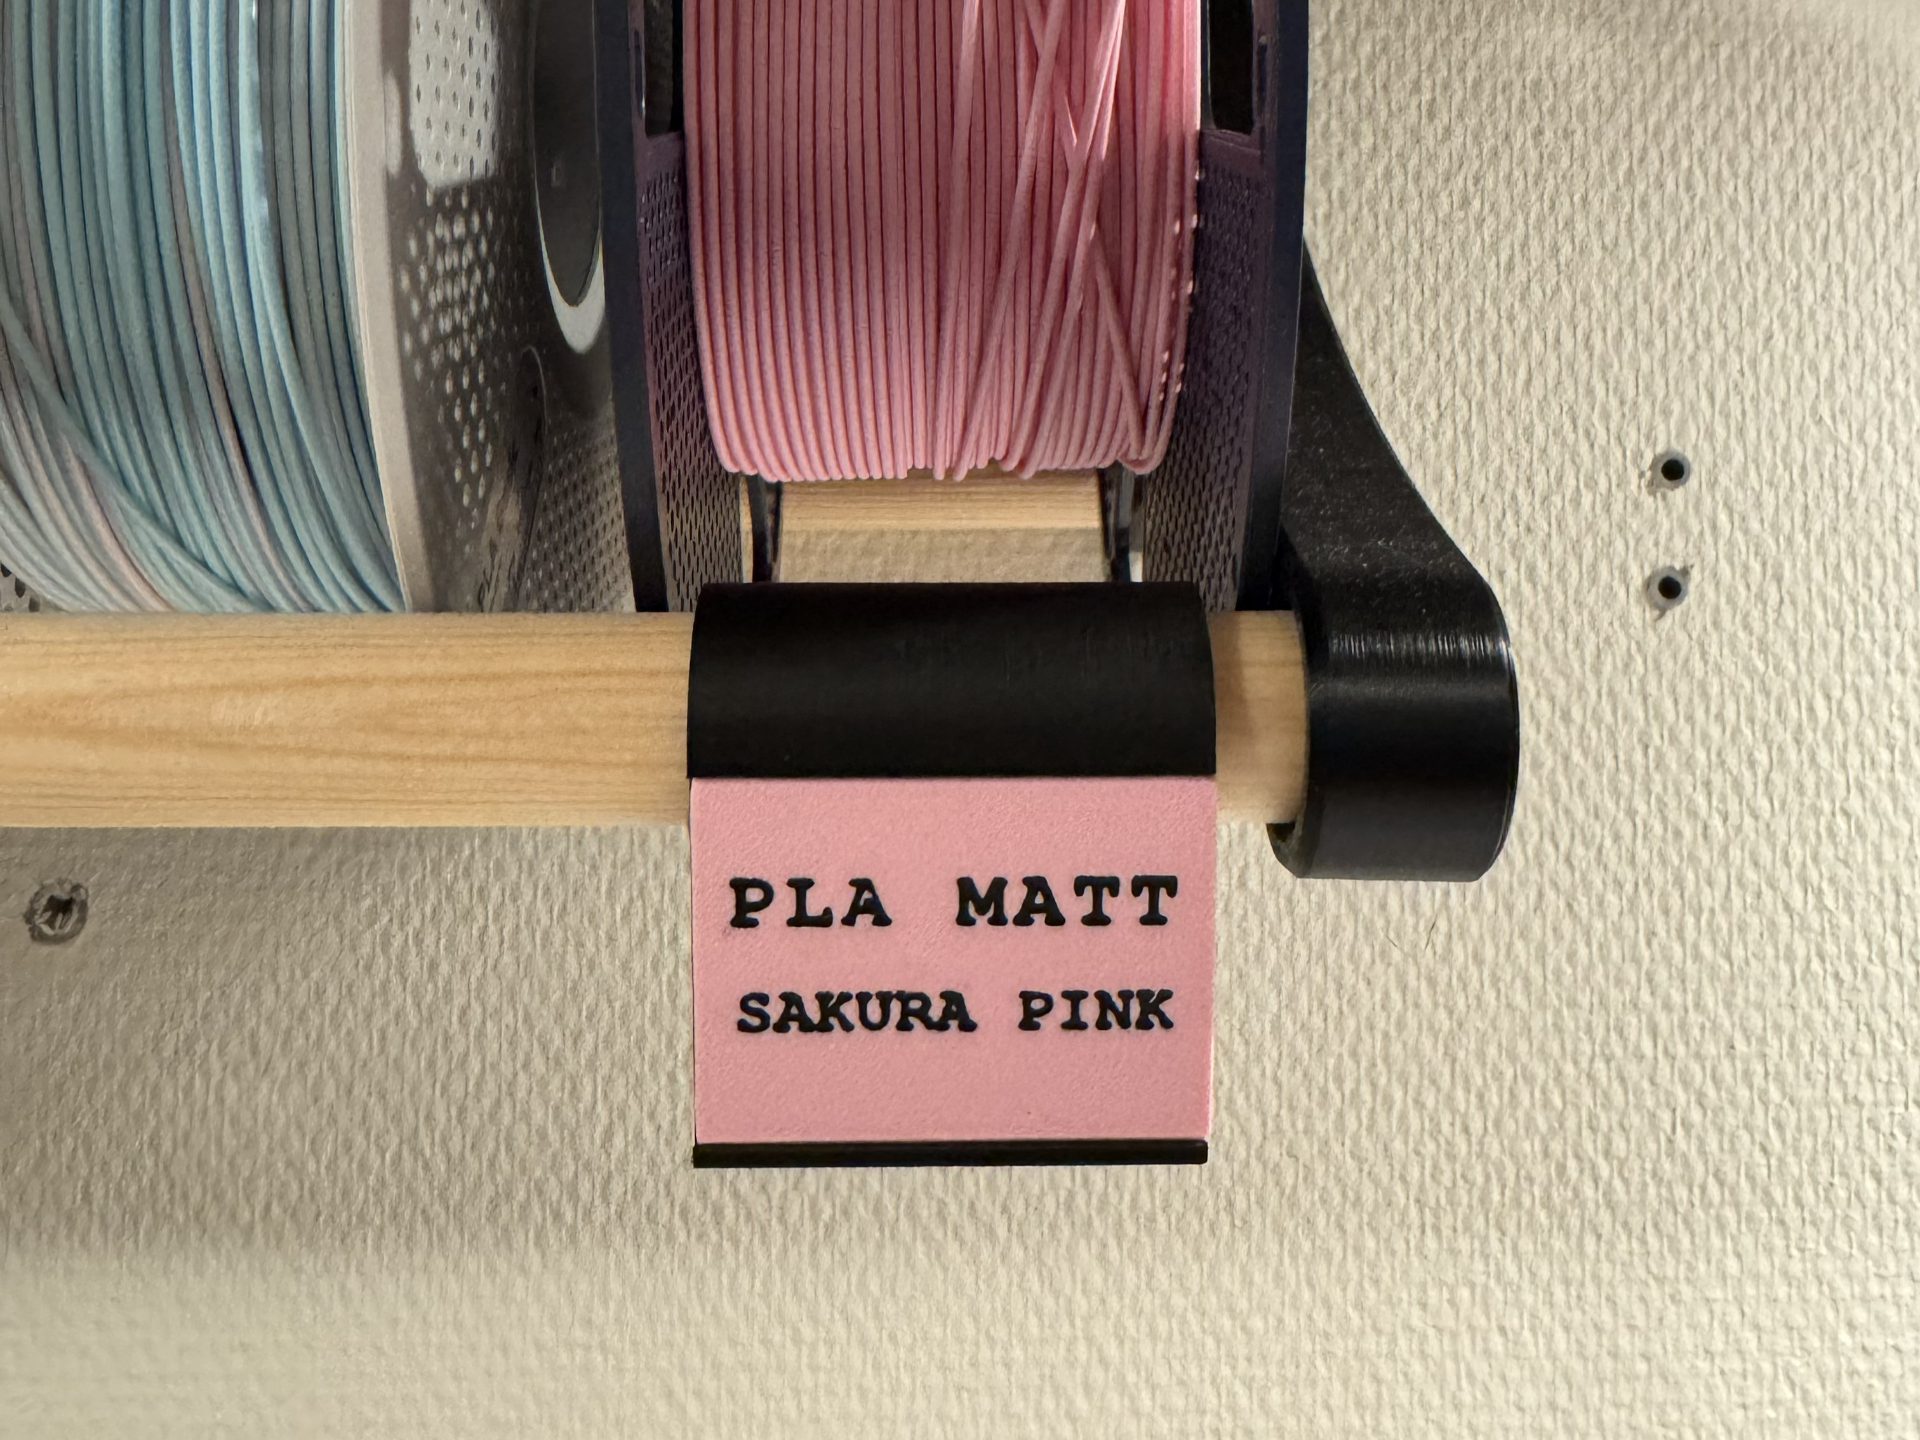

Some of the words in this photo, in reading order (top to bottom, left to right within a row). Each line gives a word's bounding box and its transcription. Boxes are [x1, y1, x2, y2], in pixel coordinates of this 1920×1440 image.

[729, 876, 893, 930] PLA
[956, 874, 1179, 928] MATT
[736, 989, 978, 1034] SAKURA
[1018, 989, 1175, 1032] PINK
